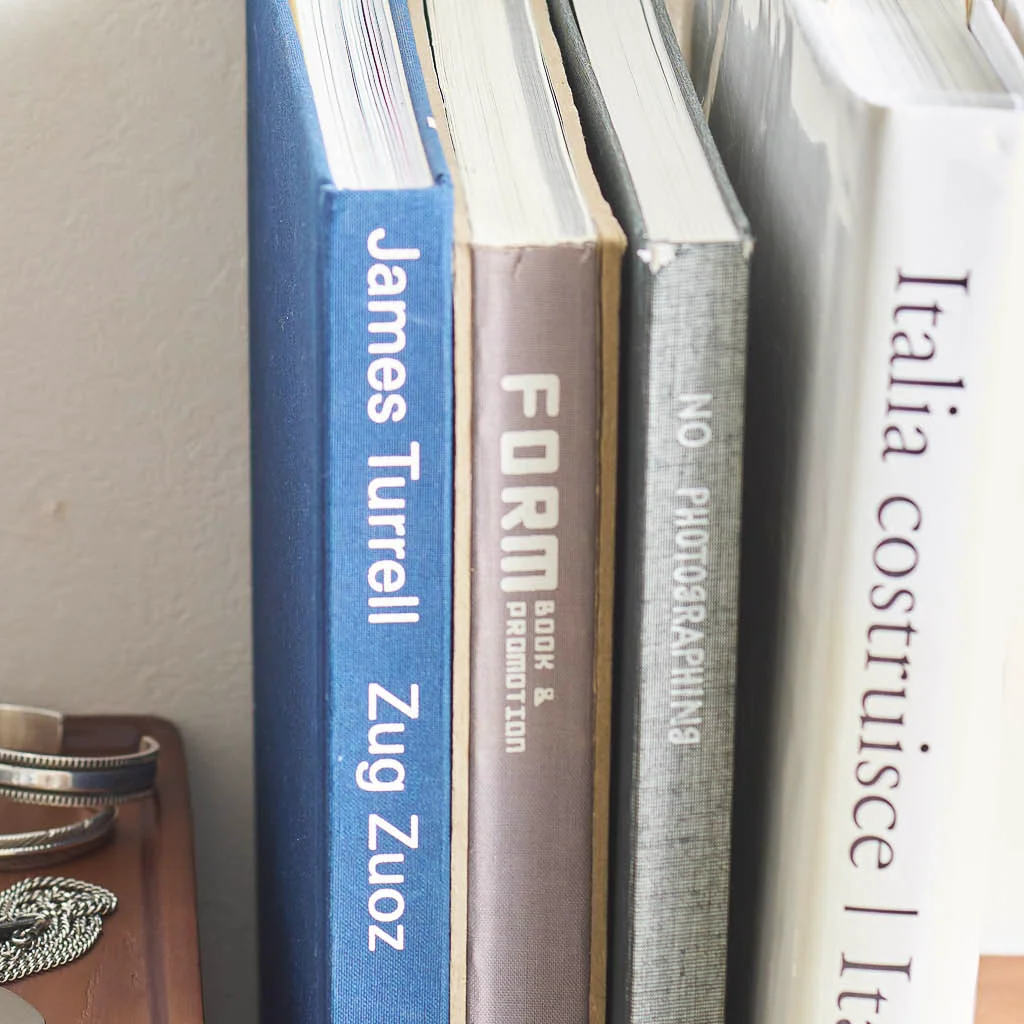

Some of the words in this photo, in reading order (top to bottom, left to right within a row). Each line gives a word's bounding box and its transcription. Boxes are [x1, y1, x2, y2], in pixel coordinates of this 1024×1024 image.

[367, 227, 421, 424] James
[880, 267, 970, 462] Italia
[499, 373, 560, 592] FORM
[676, 392, 714, 449] NO
[367, 440, 421, 625] Turrell
[505, 600, 528, 754] PROMOTION
[534, 599, 556, 670] BOOK
[534, 686, 555, 707] &
[849, 495, 930, 869] costruisce
[355, 683, 420, 792] Zug
[367, 813, 420, 952] Zuoz
